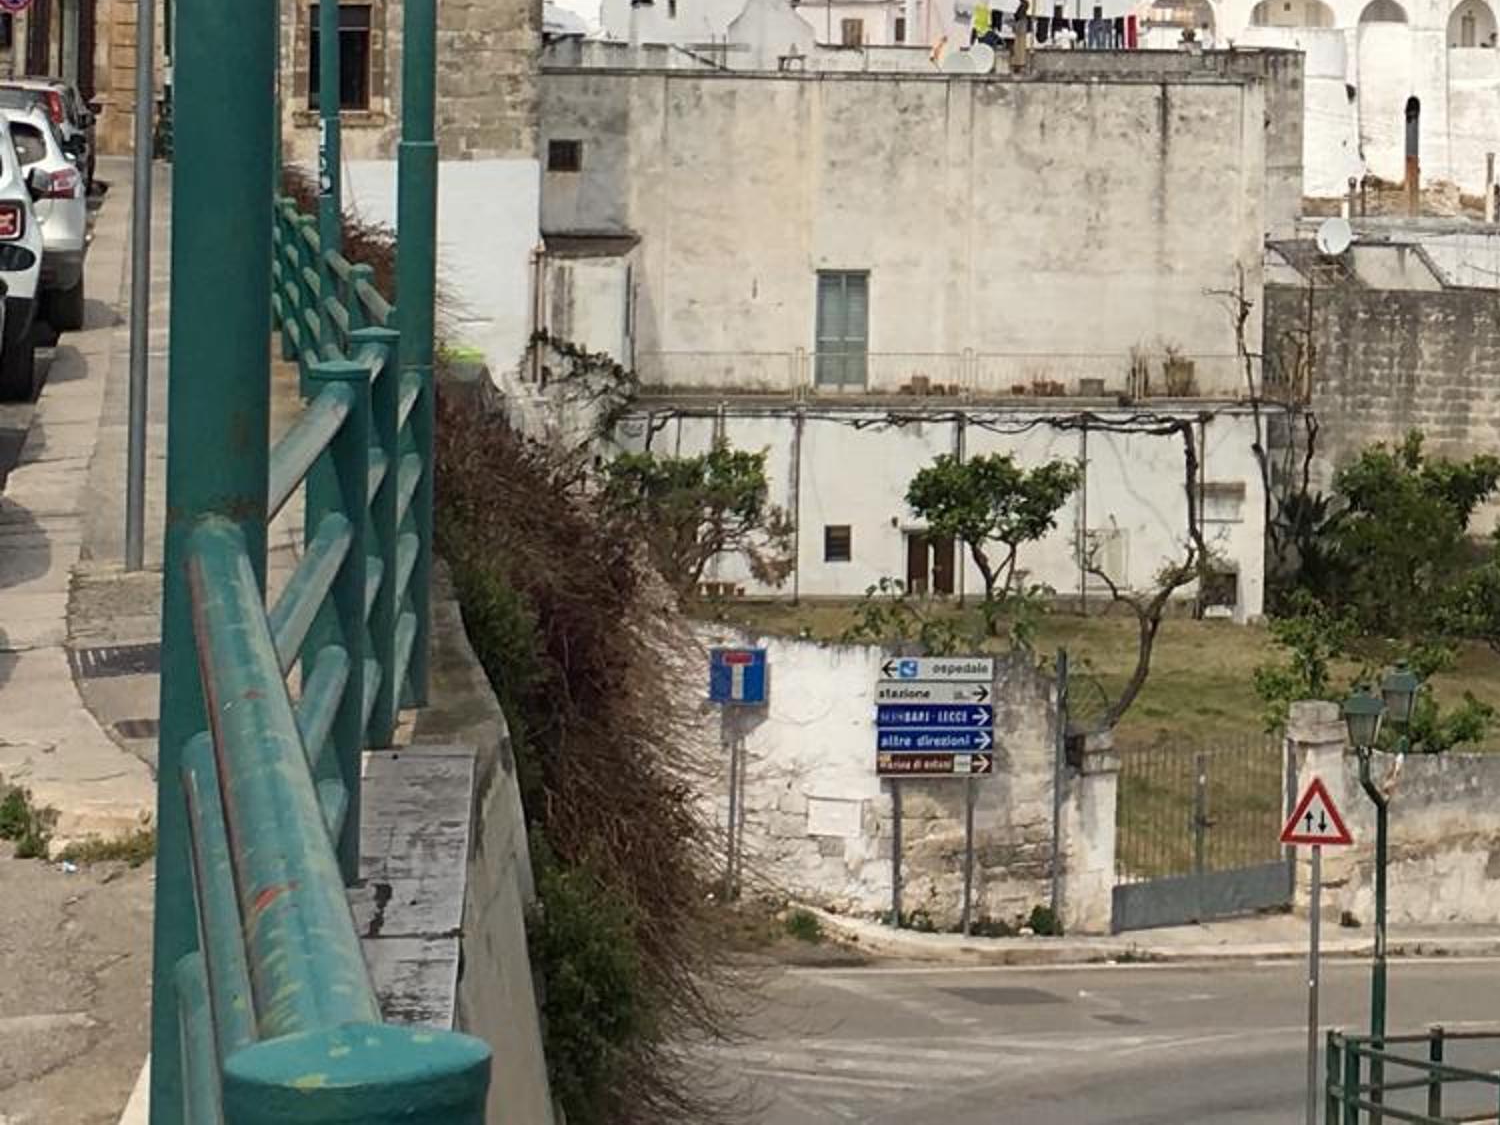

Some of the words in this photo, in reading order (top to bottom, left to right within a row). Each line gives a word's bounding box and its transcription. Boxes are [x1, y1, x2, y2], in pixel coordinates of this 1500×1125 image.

[932, 663, 989, 675] ospedale
[879, 689, 931, 699] stazione
[937, 710, 968, 722] LECCE
[880, 735, 912, 747] altre
[917, 734, 971, 747] direzioni
